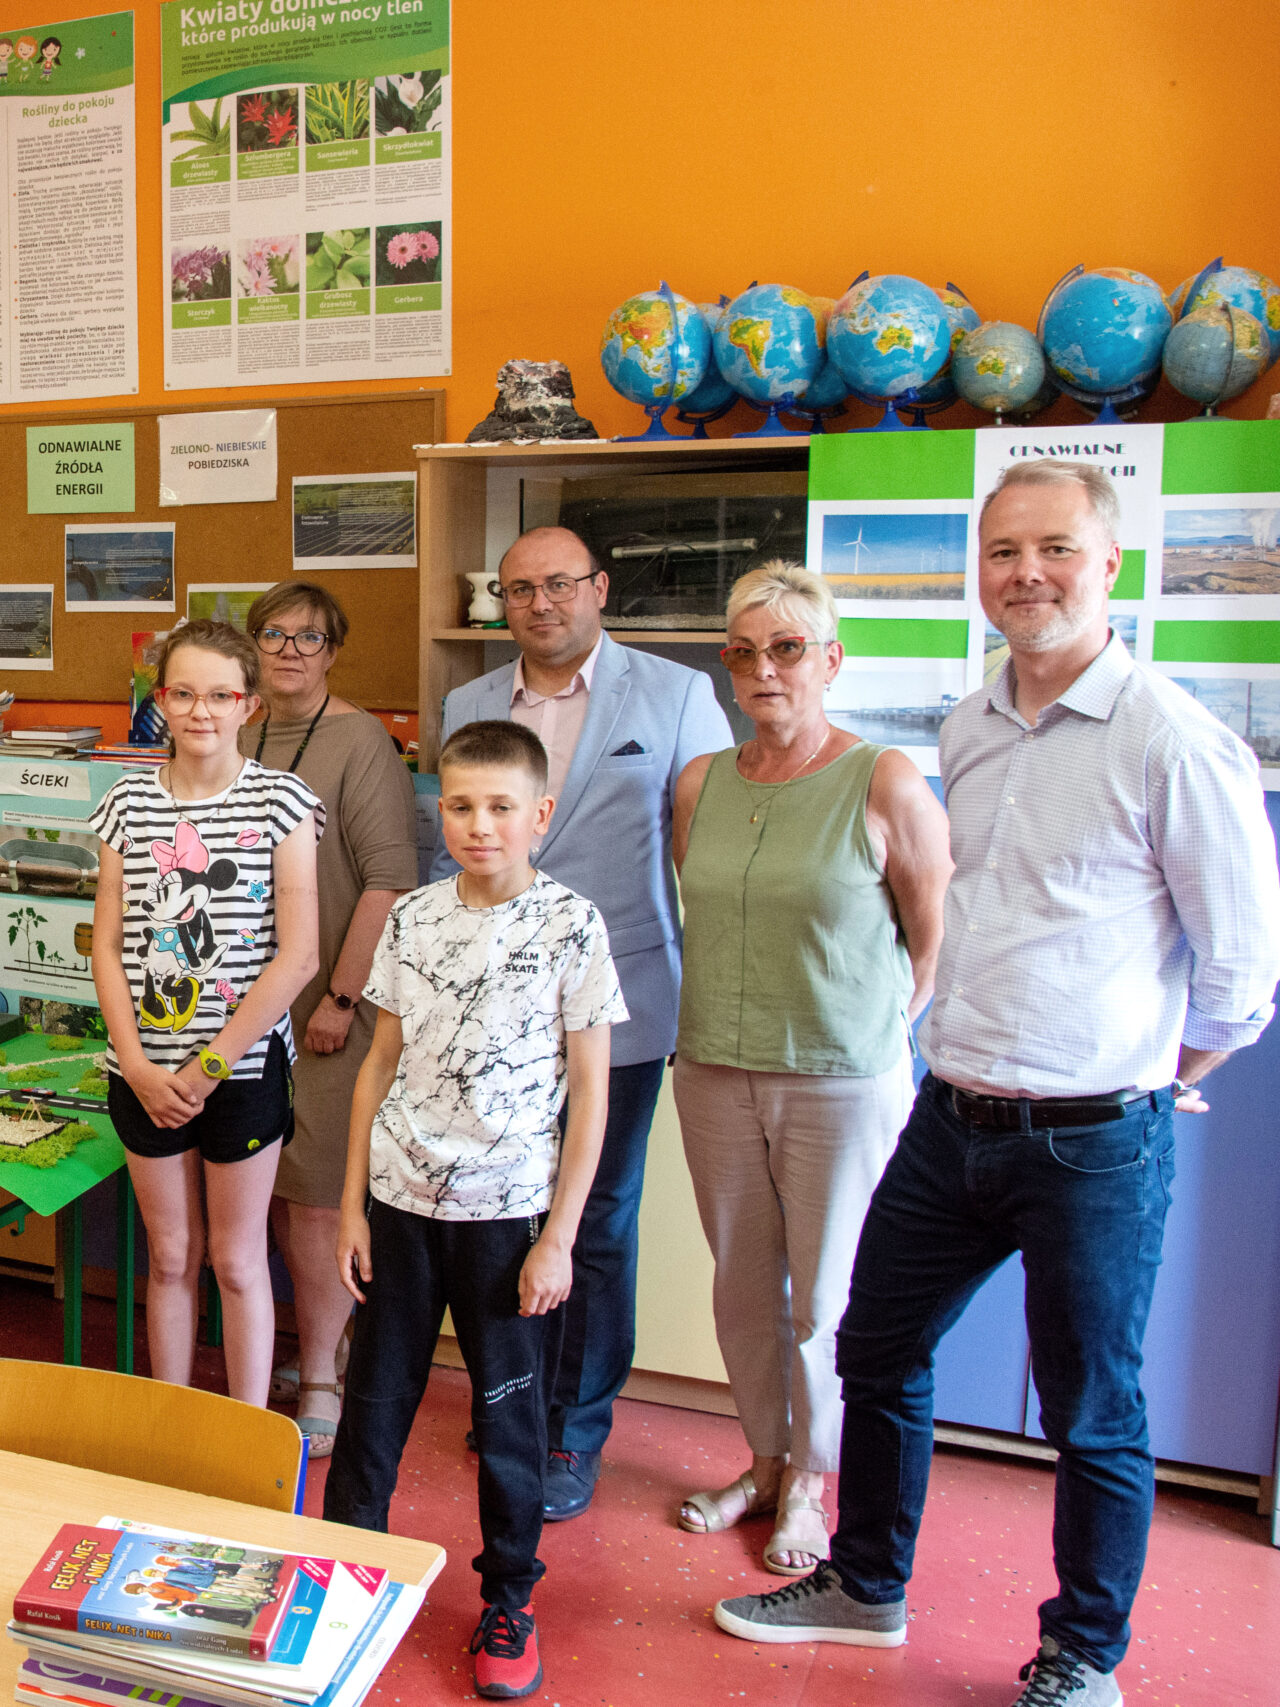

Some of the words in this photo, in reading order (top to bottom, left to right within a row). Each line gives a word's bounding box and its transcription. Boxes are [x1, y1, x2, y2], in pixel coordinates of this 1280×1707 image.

[180, 0, 262, 29] Kwiaty
[181, 29, 226, 47] które
[231, 14, 317, 43] produkują
[322, 12, 335, 25] w
[340, 3, 383, 23] nocy
[22, 104, 60, 119] Rośliny
[63, 100, 75, 111] do
[78, 94, 115, 110] pokoju
[48, 115, 88, 129] dziecka
[383, 138, 434, 152] Skrzydłokwiat
[192, 161, 210, 169] Aloes
[183, 169, 218, 179] drzewiasty
[394, 295, 424, 305] Gerbera
[187, 308, 215, 318] Storczyk
[38, 439, 122, 455] ODNAWIALNE
[171, 444, 214, 455] ZIELONO-
[216, 440, 267, 452] NIEBIESKIE
[1009, 442, 1128, 457] ODNAWIALNE
[55, 460, 104, 475] ŹRÓDŁA
[188, 458, 250, 470] POBIEDZISKA
[56, 483, 104, 496] ENERGII
[20, 770, 69, 788] ŚCIEKI
[508, 951, 539, 961] HRLM
[505, 964, 539, 975] SKATE
[48, 1559, 87, 1590] FELIX,
[70, 1539, 100, 1560] NET
[83, 1552, 115, 1579] NIKA
[26, 1609, 43, 1619] Rafał
[44, 1611, 62, 1622] Kosik
[84, 1618, 115, 1634] FELIX,
[116, 1624, 137, 1637] NET
[138, 1627, 144, 1637] i
[146, 1628, 172, 1641] NIKA
[210, 1636, 227, 1646] Gang
